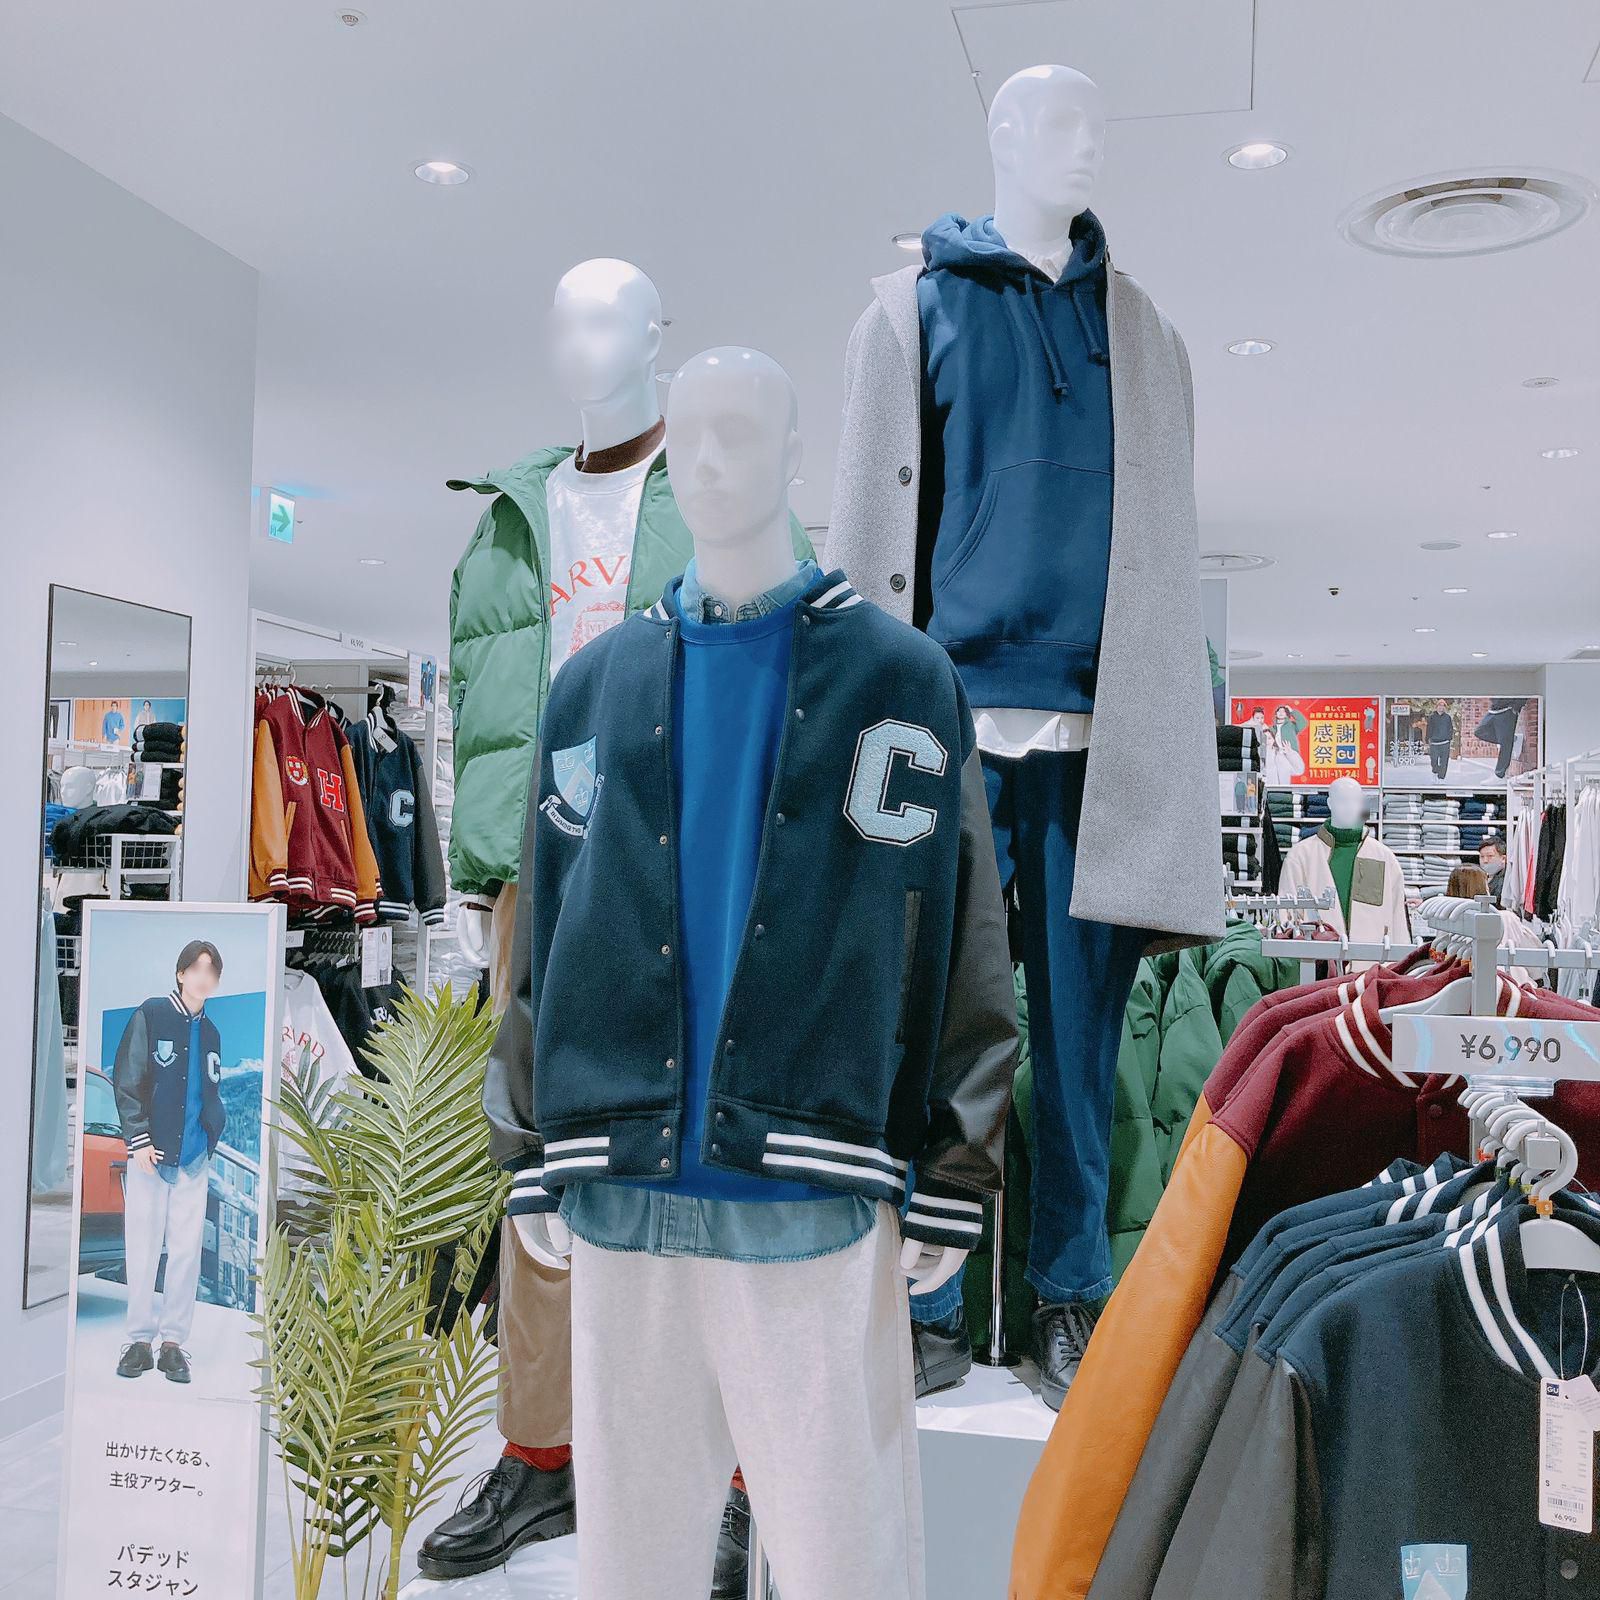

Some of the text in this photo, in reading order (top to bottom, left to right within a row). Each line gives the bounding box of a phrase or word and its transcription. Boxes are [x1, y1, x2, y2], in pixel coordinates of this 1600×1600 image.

[550, 553, 630, 617] ARV
[1313, 723, 1356, 743] 感謝
[1314, 745, 1333, 764] 祭
[1336, 749, 1356, 760] GU
[317, 767, 345, 813] H
[843, 718, 948, 847] C
[389, 789, 415, 828] C
[1460, 1033, 1561, 1064] ¥6,990
[1547, 1386, 1559, 1394] GU
[106, 1441, 211, 1468] 出かけたくなる、
[109, 1470, 204, 1497] 主役アウター。
[1545, 1479, 1550, 1487] S
[117, 1543, 190, 1569] パデッド
[108, 1569, 199, 1597] スタジャン
